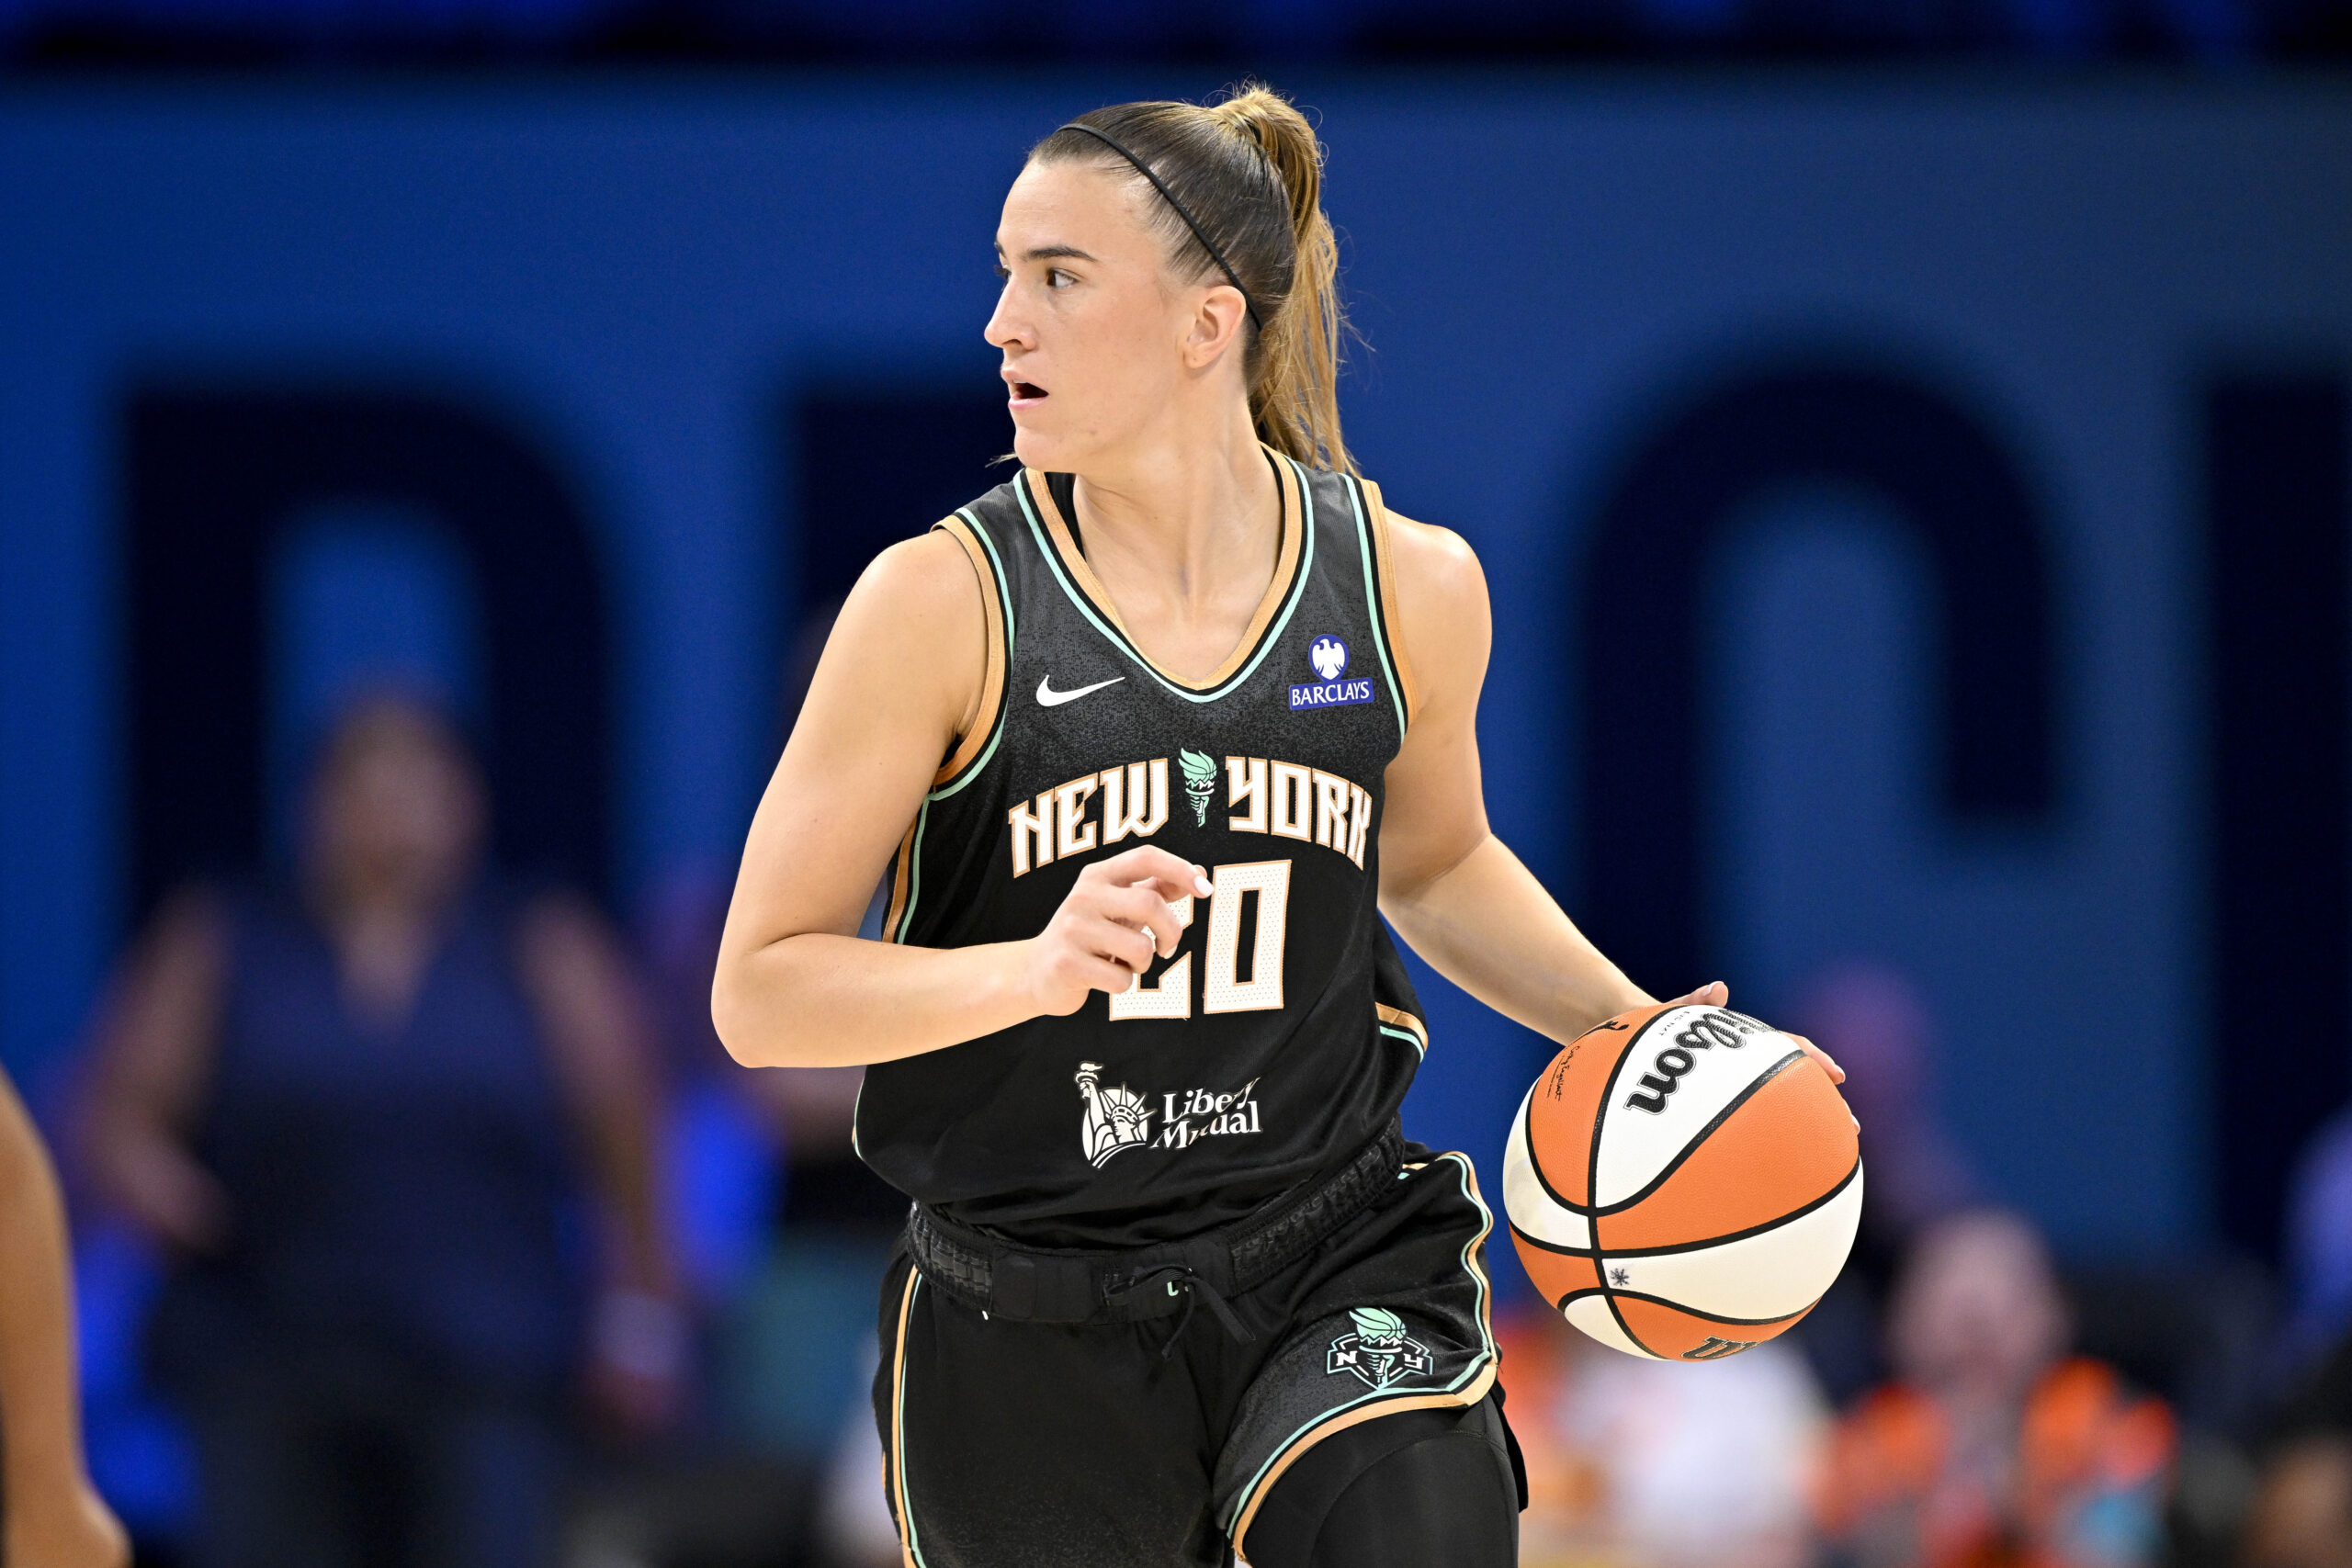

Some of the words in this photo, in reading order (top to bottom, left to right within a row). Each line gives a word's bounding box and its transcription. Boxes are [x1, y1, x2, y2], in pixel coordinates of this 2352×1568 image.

[1292, 681, 1370, 706] BARCLAYS
[1008, 757, 1169, 879] NEW
[1225, 755, 1373, 872] YORK
[1162, 1077, 1261, 1123] Libey
[1148, 1100, 1262, 1149] Mual
[1336, 1350, 1358, 1367] N
